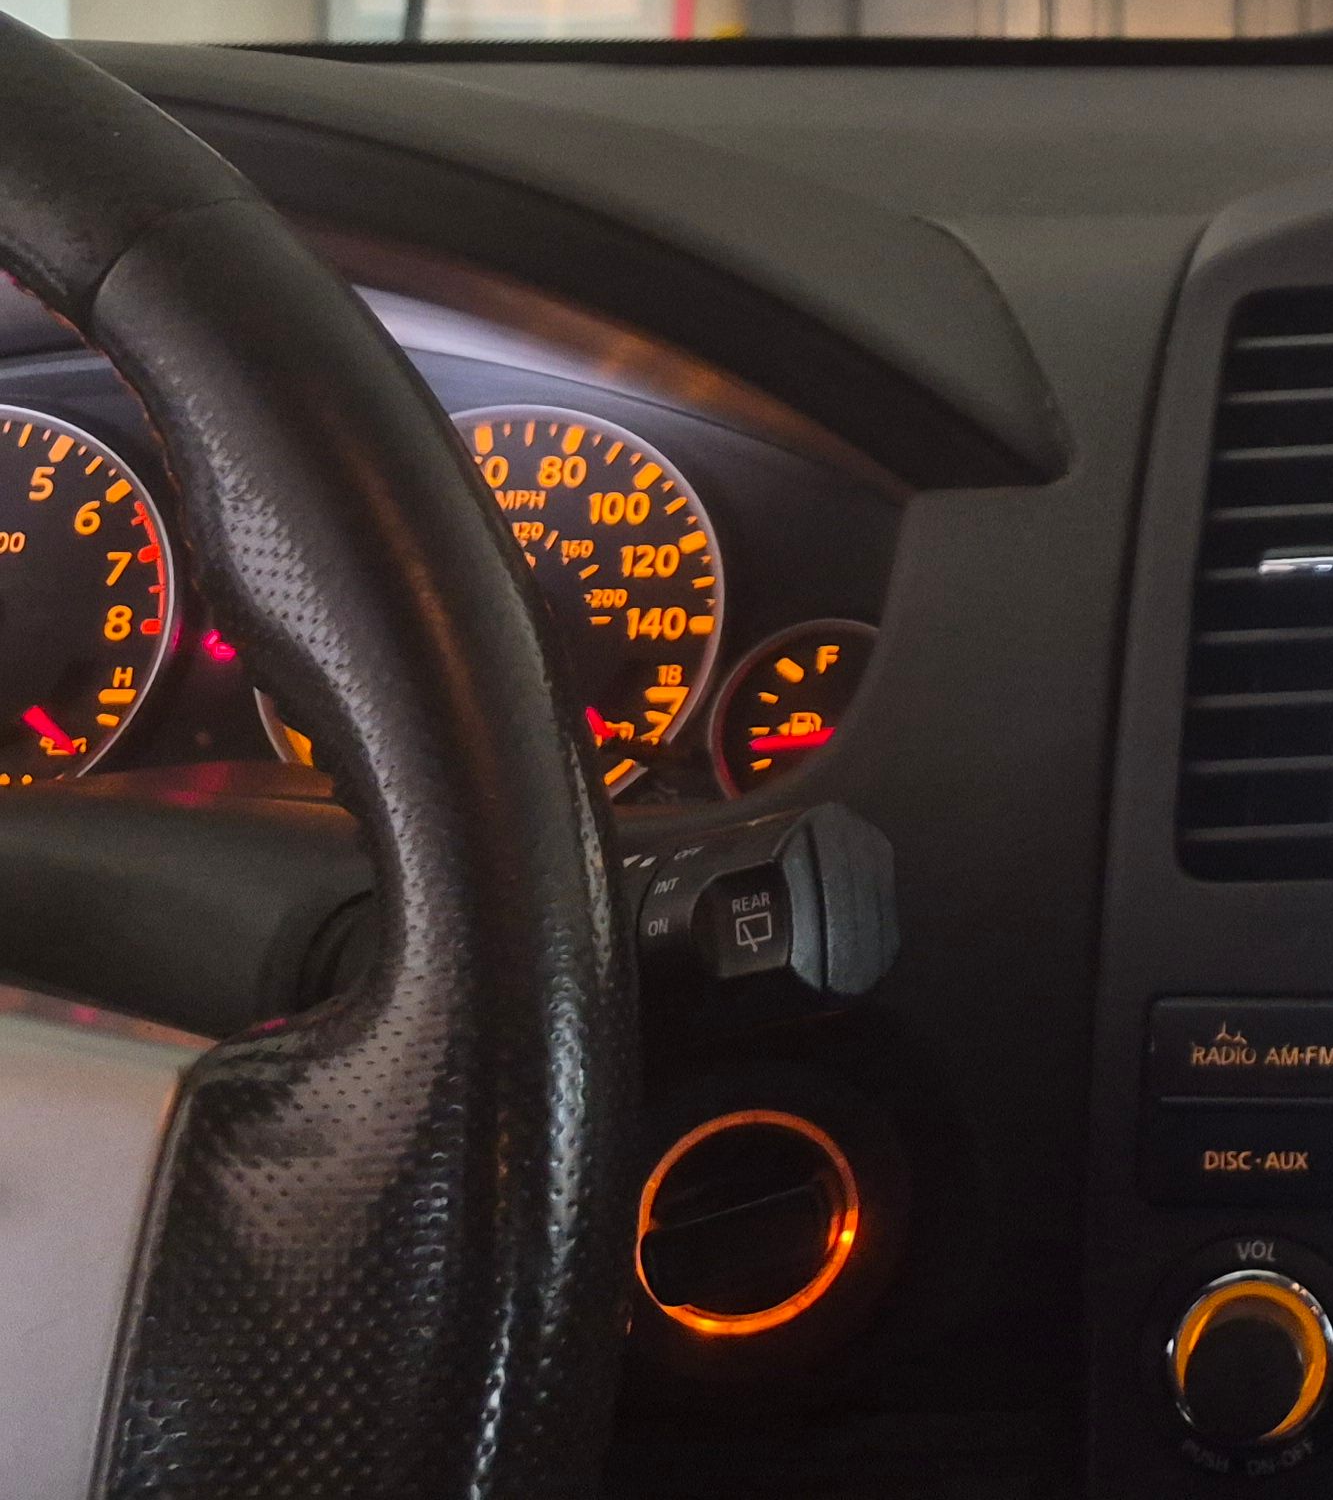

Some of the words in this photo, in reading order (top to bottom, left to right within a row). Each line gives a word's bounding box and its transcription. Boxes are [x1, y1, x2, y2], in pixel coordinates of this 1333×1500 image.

[537, 455, 587, 488] 80
[28, 466, 56, 500] 5
[495, 490, 546, 510] MPH
[589, 491, 650, 525] 100
[74, 501, 100, 535] 6
[512, 521, 544, 542] 120
[561, 540, 594, 558] 160
[106, 552, 132, 586] 7
[621, 544, 680, 577] 120
[590, 589, 628, 609] 200
[104, 605, 133, 641] 8
[626, 606, 687, 640] 140
[816, 645, 840, 674] F
[112, 666, 134, 688] H
[656, 664, 683, 686] 18
[653, 876, 680, 895] INT
[731, 891, 771, 913] REAR
[647, 917, 669, 936] ON
[1191, 1046, 1257, 1067] RADIO
[1236, 1240, 1277, 1262] VOL
